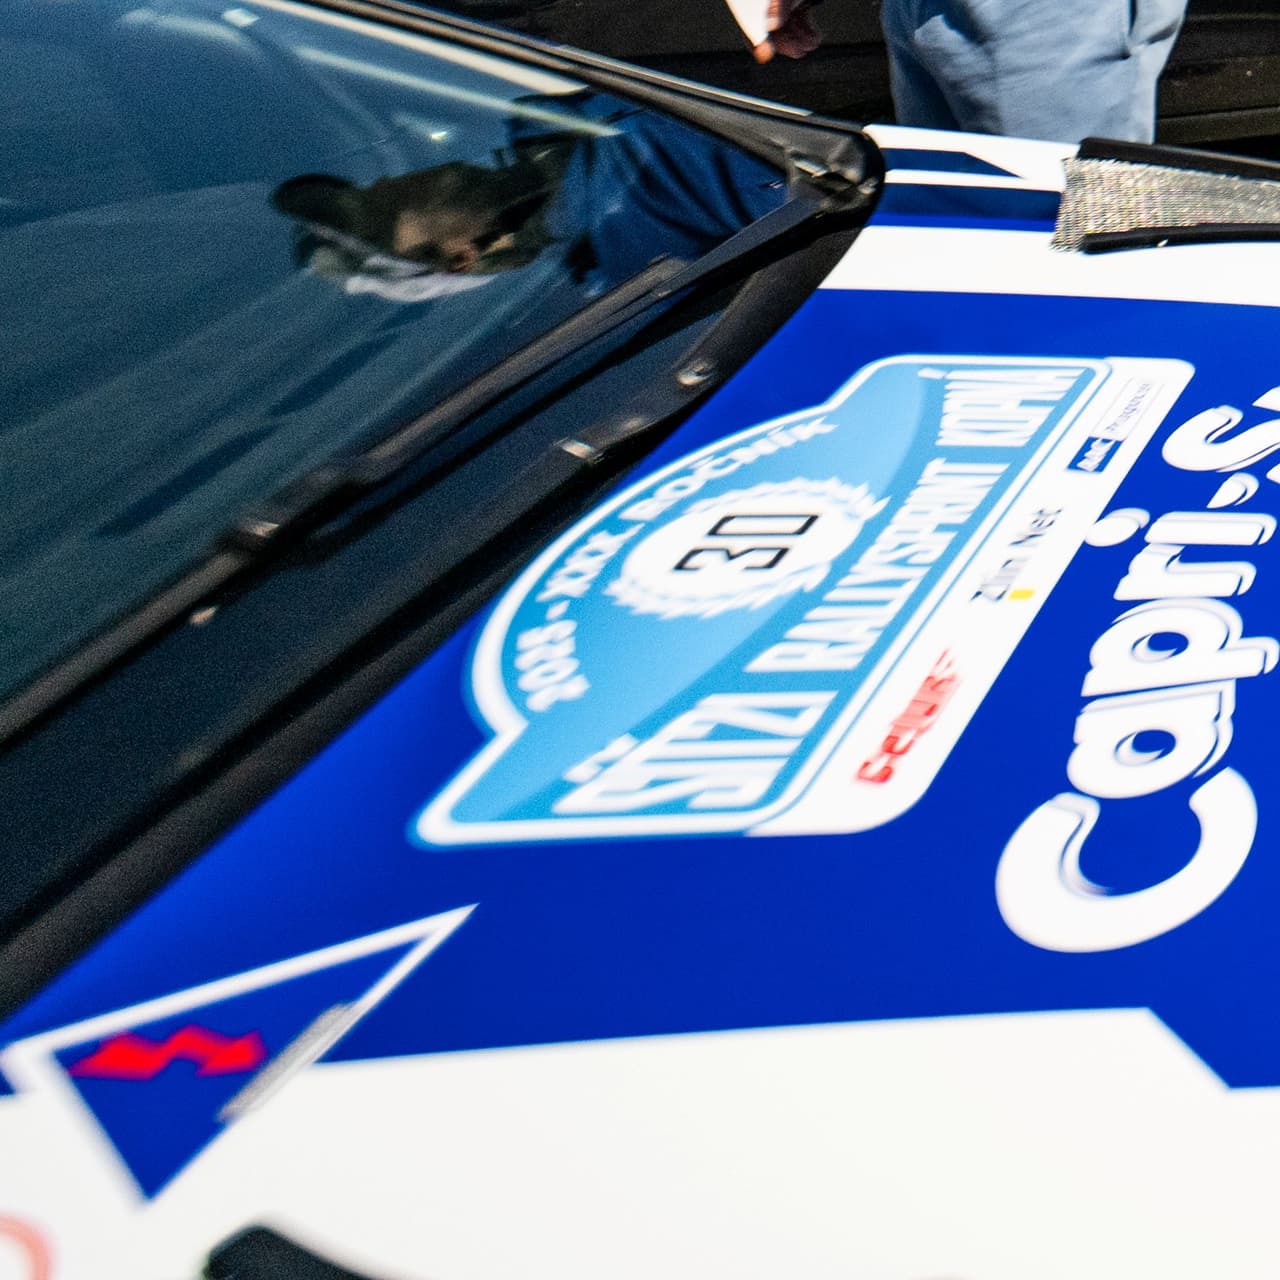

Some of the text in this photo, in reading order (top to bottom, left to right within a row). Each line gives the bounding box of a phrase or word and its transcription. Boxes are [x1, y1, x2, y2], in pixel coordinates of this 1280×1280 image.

[670, 511, 820, 573] 30
[742, 457, 1006, 674] RALLYSPRINT
[917, 365, 1085, 448] KOPNÁ
[1008, 506, 1064, 549] Net
[514, 620, 591, 712] 2025
